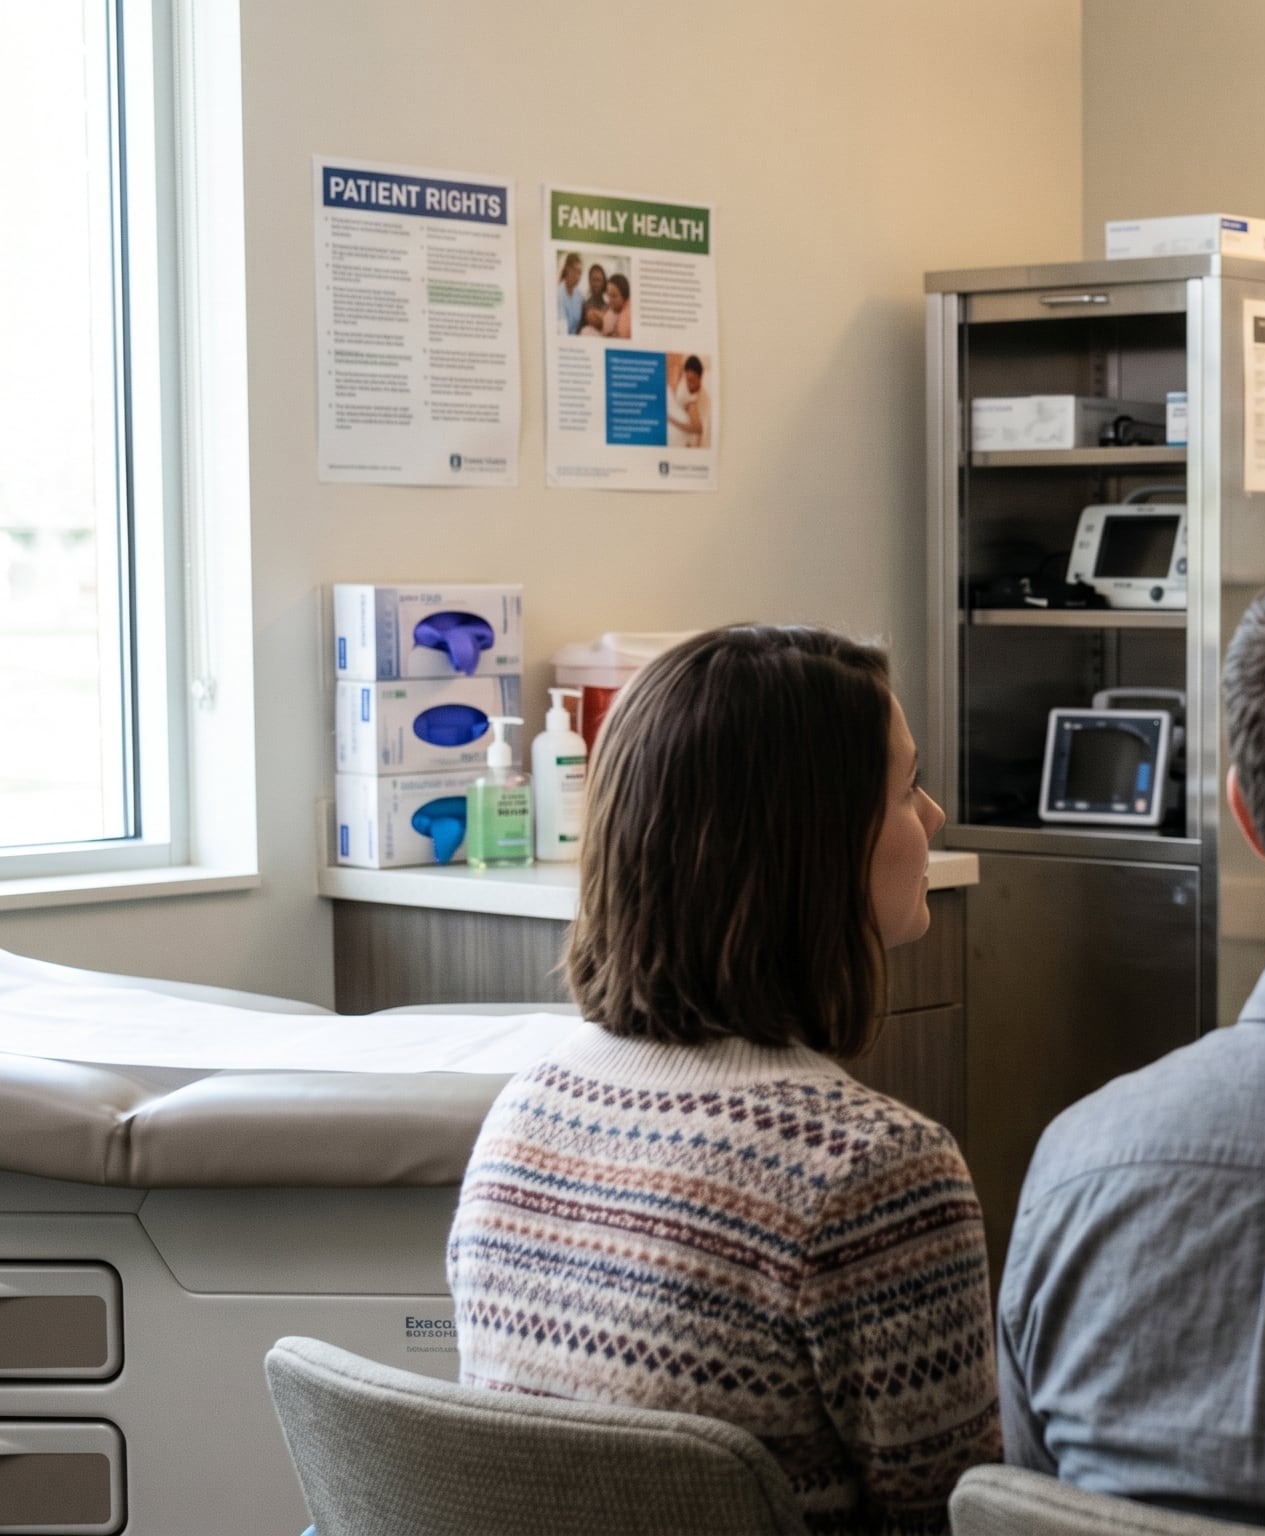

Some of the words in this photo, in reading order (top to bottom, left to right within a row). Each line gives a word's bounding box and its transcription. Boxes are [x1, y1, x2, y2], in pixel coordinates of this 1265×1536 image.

[329, 175, 421, 208] PATIENT
[425, 187, 502, 218] RIGHTS
[557, 204, 629, 234] FAMILY
[632, 212, 705, 243] HEALTH
